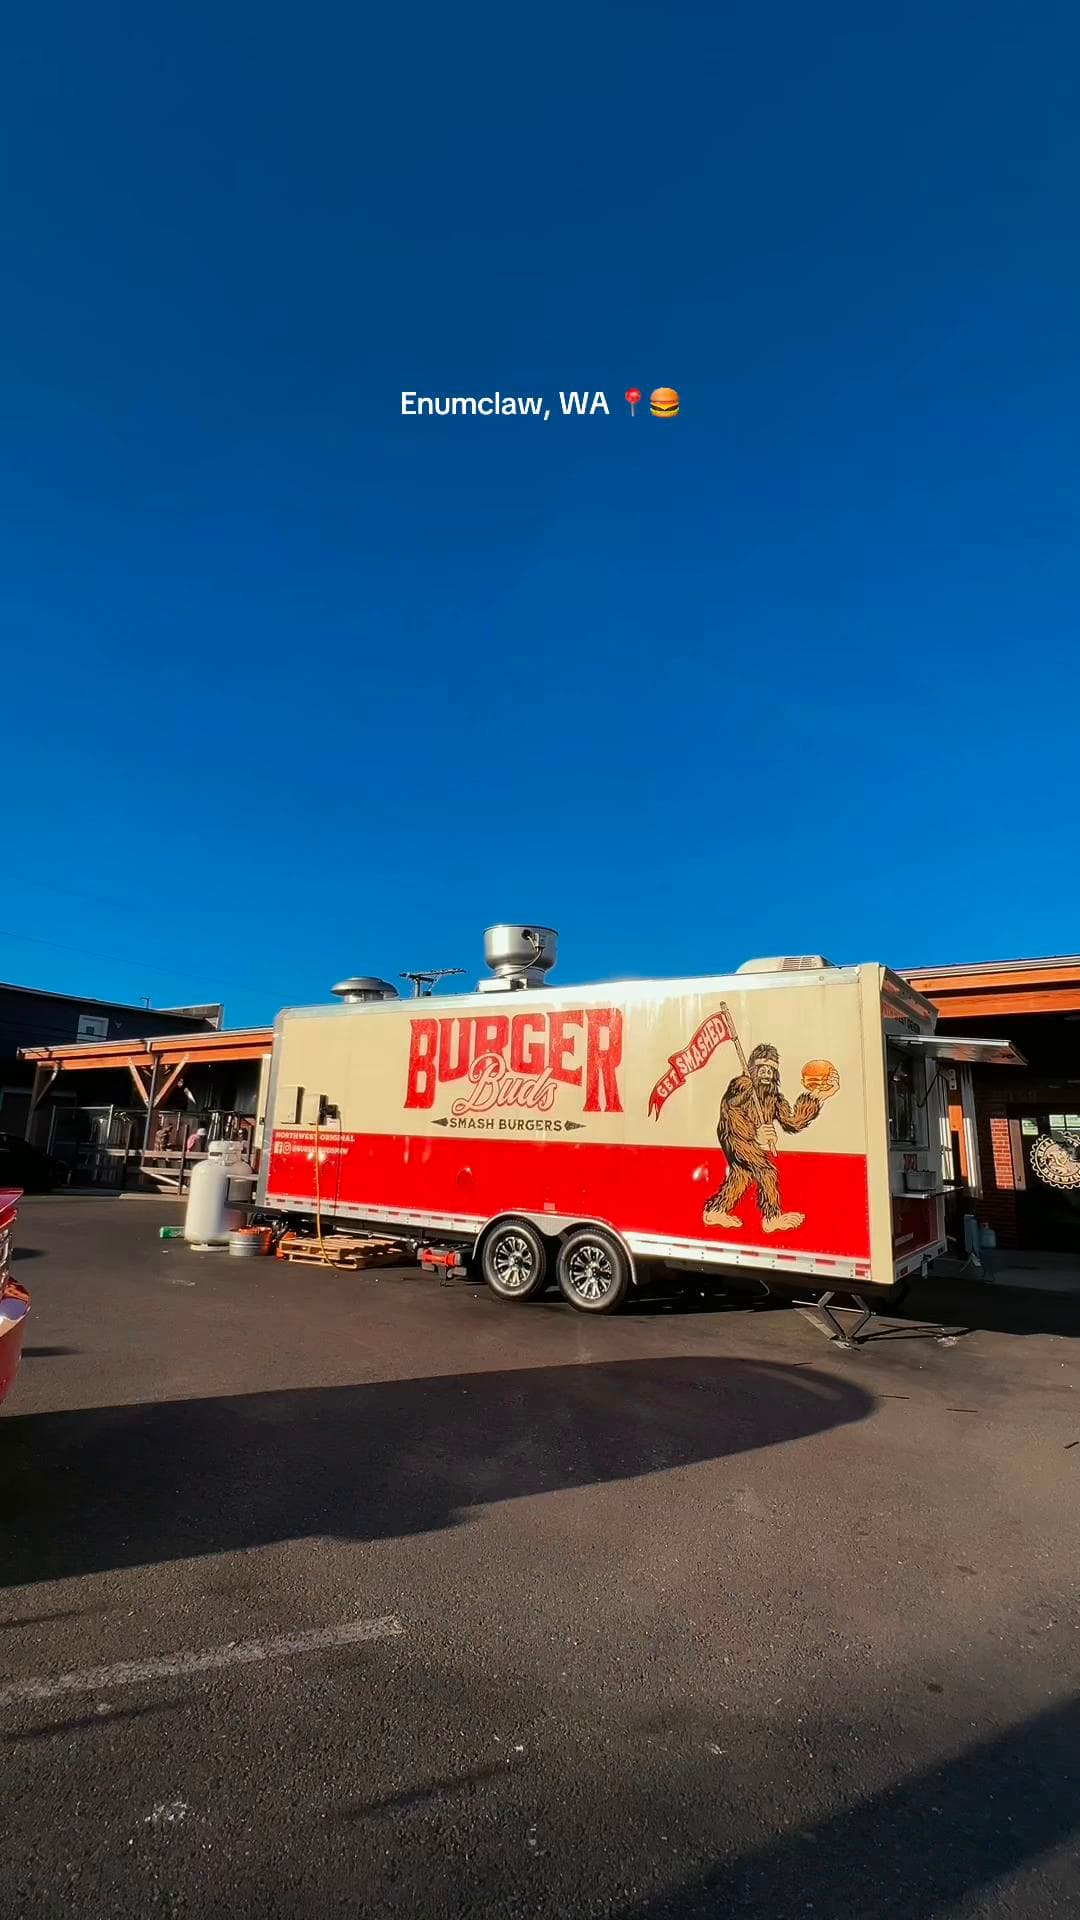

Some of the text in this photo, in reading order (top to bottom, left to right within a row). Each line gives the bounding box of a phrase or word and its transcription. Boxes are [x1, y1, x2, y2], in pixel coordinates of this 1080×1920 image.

[404, 1008, 624, 1112] BURGER
[452, 1052, 558, 1116] Buds
[657, 1071, 678, 1098] GET
[275, 1131, 355, 1143] NORTHWEST ORIGINAL
[449, 1118, 562, 1131] SMASH BURGERS
